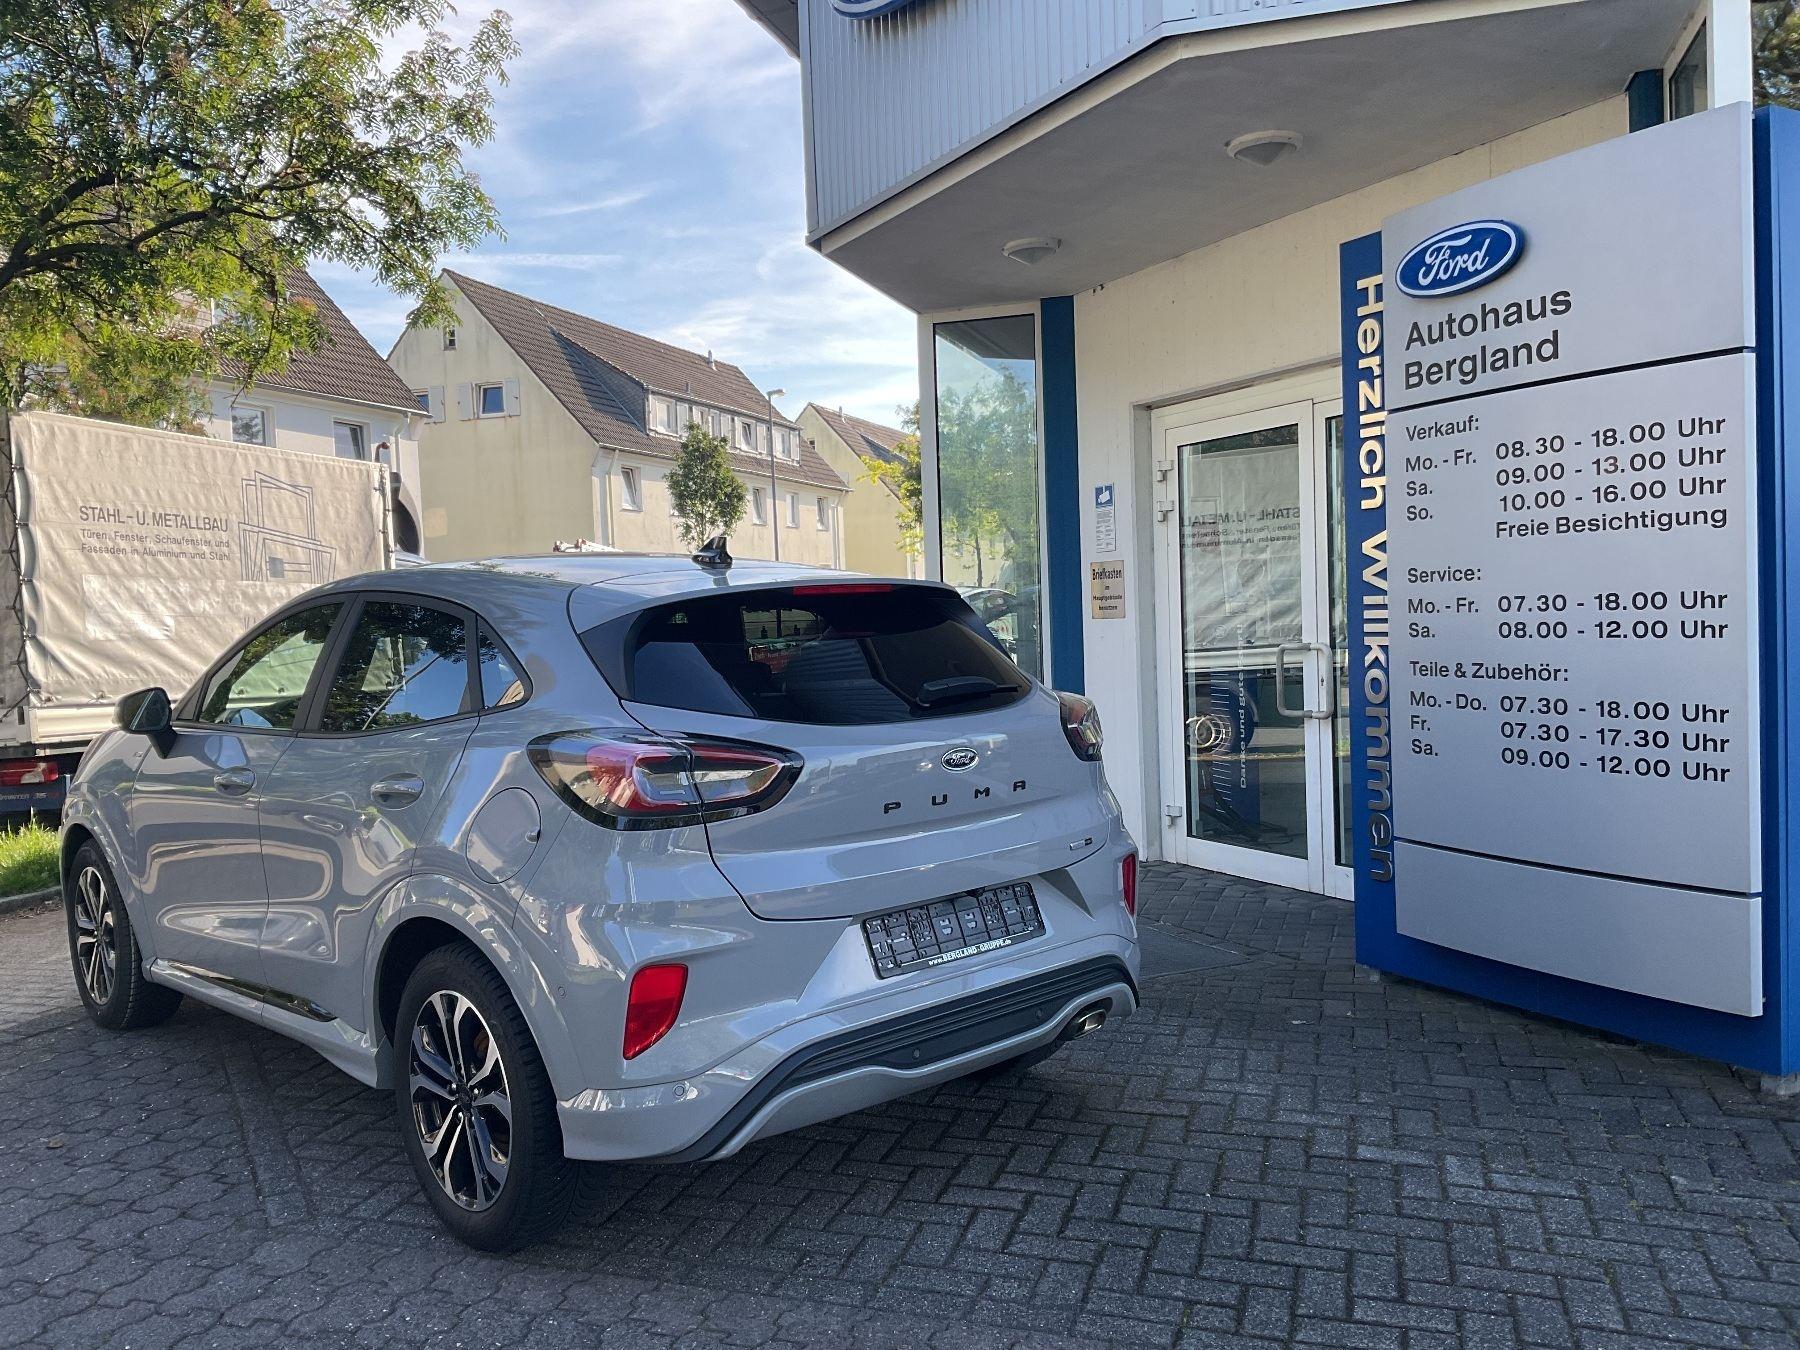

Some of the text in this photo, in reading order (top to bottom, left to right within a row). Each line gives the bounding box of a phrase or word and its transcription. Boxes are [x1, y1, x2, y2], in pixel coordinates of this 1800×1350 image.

[1418, 234, 1490, 286] Ford
[1405, 290, 1572, 351] Autohaus
[1404, 330, 1560, 390] Bergland
[1356, 274, 1388, 510] Herzlich
[1405, 415, 1480, 442] Verkauf:
[1495, 435, 1565, 460] 08.30
[1591, 422, 1666, 448] 18.00
[1678, 417, 1726, 438] Uhr
[1406, 481, 1433, 497] Sa.
[1495, 462, 1565, 486] 09.00
[1591, 451, 1666, 476] 13.00
[1678, 447, 1726, 467] Uhr
[1406, 505, 1433, 521] So.
[1499, 489, 1565, 512] 10.00
[1592, 480, 1667, 504] 16.00
[1679, 476, 1727, 497] Uhr
[152, 512, 228, 533] METALLBAU
[1495, 507, 1727, 538] Freie Besichtigung
[81, 543, 230, 561] Fassaden in Aluminium und Stahl
[215, 539, 229, 549] und
[1407, 566, 1481, 583] Service:
[1498, 594, 1567, 612] 07.30
[1593, 591, 1668, 611] 18.00
[1680, 590, 1727, 610] Uhr
[1408, 623, 1435, 638] Sa.
[1498, 621, 1568, 639] 08.00
[1594, 620, 1668, 639] 12.00
[1680, 620, 1728, 639] Uhr
[1238, 671, 1246, 707] gute
[1409, 661, 1569, 682] Teile & Zubehör:
[1362, 529, 1394, 883] Willkommen
[1500, 696, 1568, 716] 07.30
[1596, 701, 1670, 721] 18.00
[1682, 704, 1729, 723] Uhr
[1410, 715, 1431, 732] Fr.
[1500, 722, 1569, 743] 07.30
[1596, 728, 1670, 749] 17.30
[1682, 732, 1730, 752] Uhr
[1411, 739, 1439, 756] Sa.
[1501, 747, 1570, 770] 09.00
[1597, 756, 1670, 778] 12.00
[1683, 761, 1730, 782] Uhr
[883, 780, 1027, 814] PUMA
